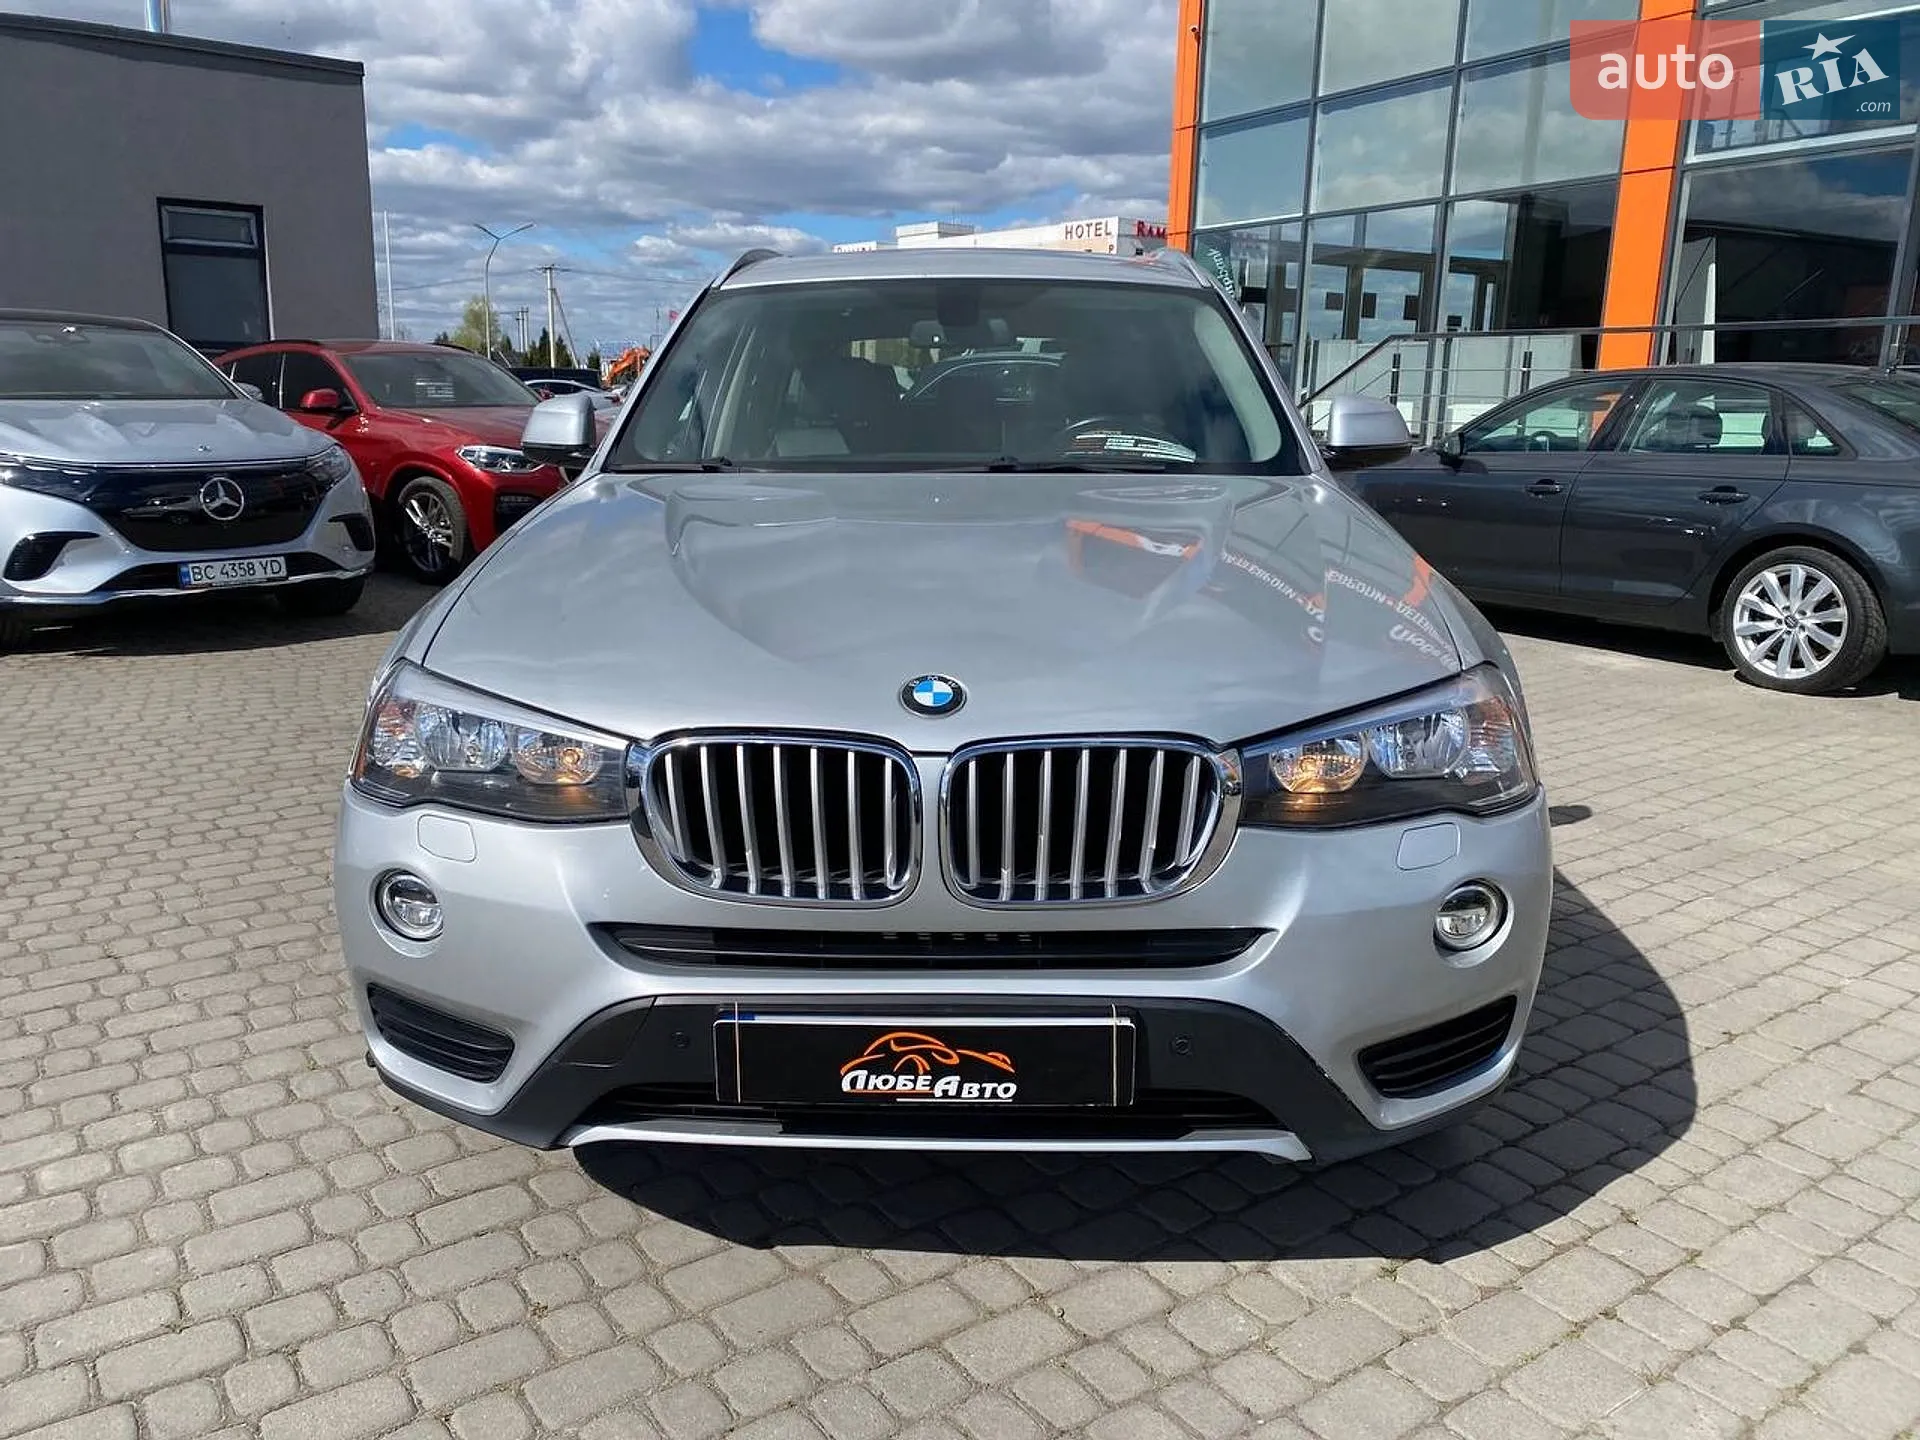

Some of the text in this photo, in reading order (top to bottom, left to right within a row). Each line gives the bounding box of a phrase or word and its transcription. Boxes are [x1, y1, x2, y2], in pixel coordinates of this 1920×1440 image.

[1064, 220, 1112, 240] HOTEL
[1136, 220, 1168, 240] RAM
[191, 565, 216, 582] BC
[220, 562, 256, 579] 4358
[258, 559, 282, 576] YD
